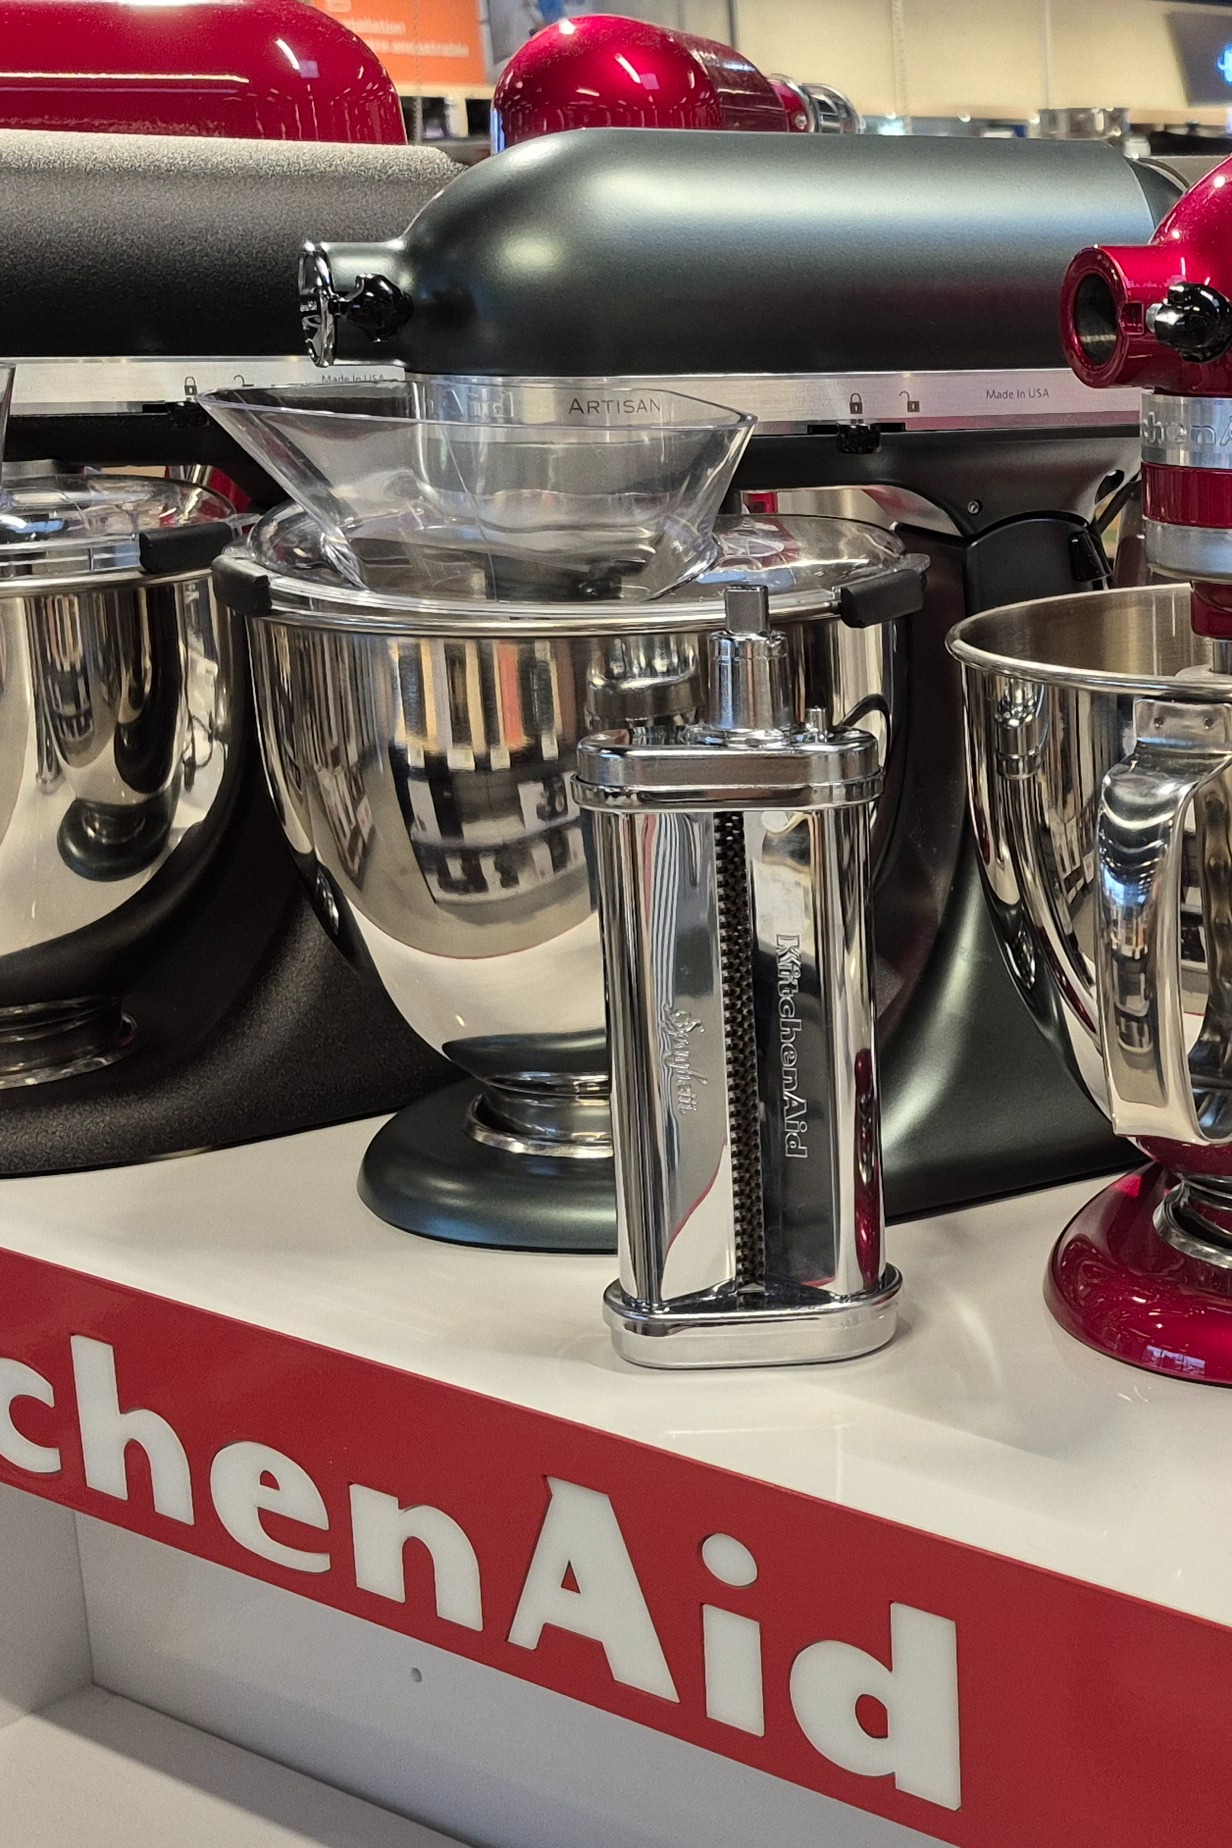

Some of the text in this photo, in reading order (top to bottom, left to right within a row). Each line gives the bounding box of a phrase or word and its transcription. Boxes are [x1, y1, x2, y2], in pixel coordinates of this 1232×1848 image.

[985, 388, 1050, 400] Made In USA
[776, 934, 809, 1159] KitchenAid
